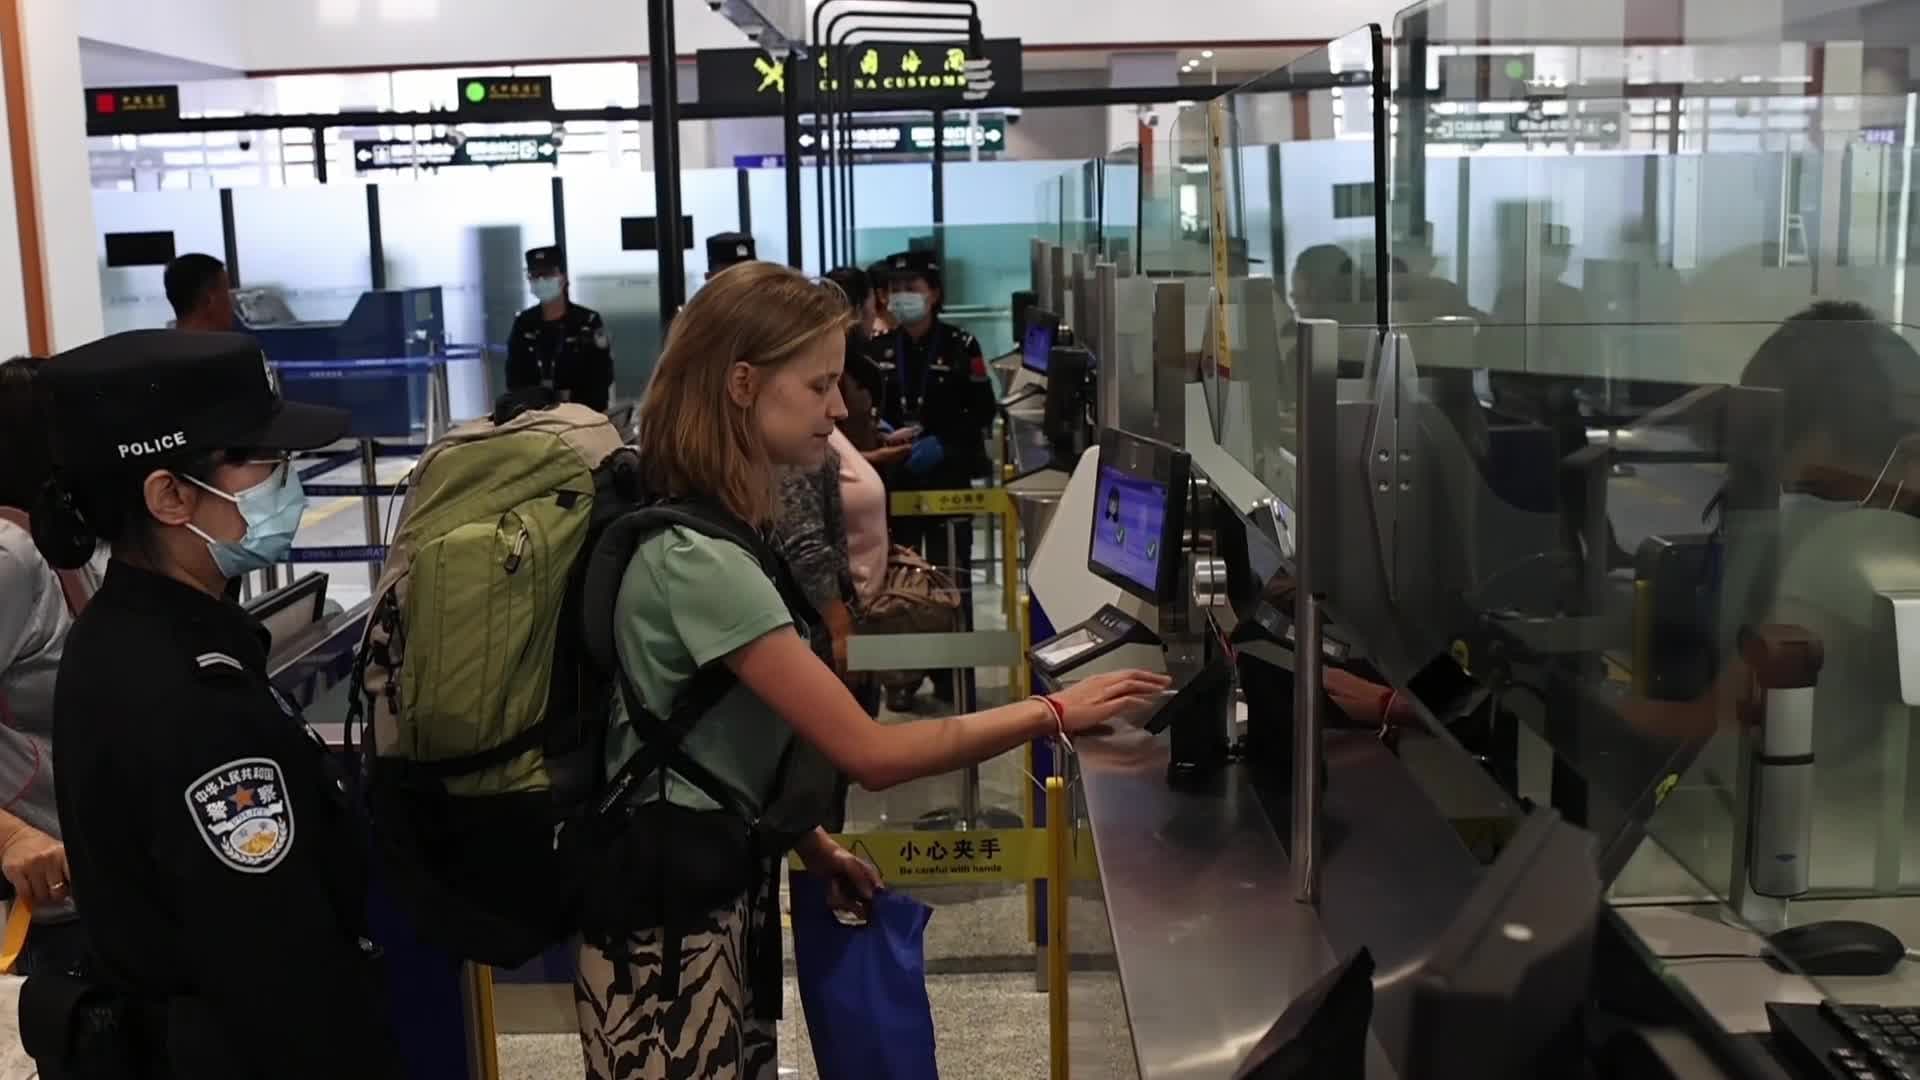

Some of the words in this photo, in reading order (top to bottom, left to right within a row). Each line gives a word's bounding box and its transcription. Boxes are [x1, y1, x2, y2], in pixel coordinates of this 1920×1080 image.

[818, 78, 877, 91] CHNA
[882, 75, 966, 89] CUSTOMS
[118, 431, 187, 459] POLICE
[194, 767, 275, 804] 中华人民共和国
[899, 837, 1001, 862] 小心夹手
[899, 865, 912, 875] Be
[915, 864, 948, 875] careful
[950, 864, 970, 874] with
